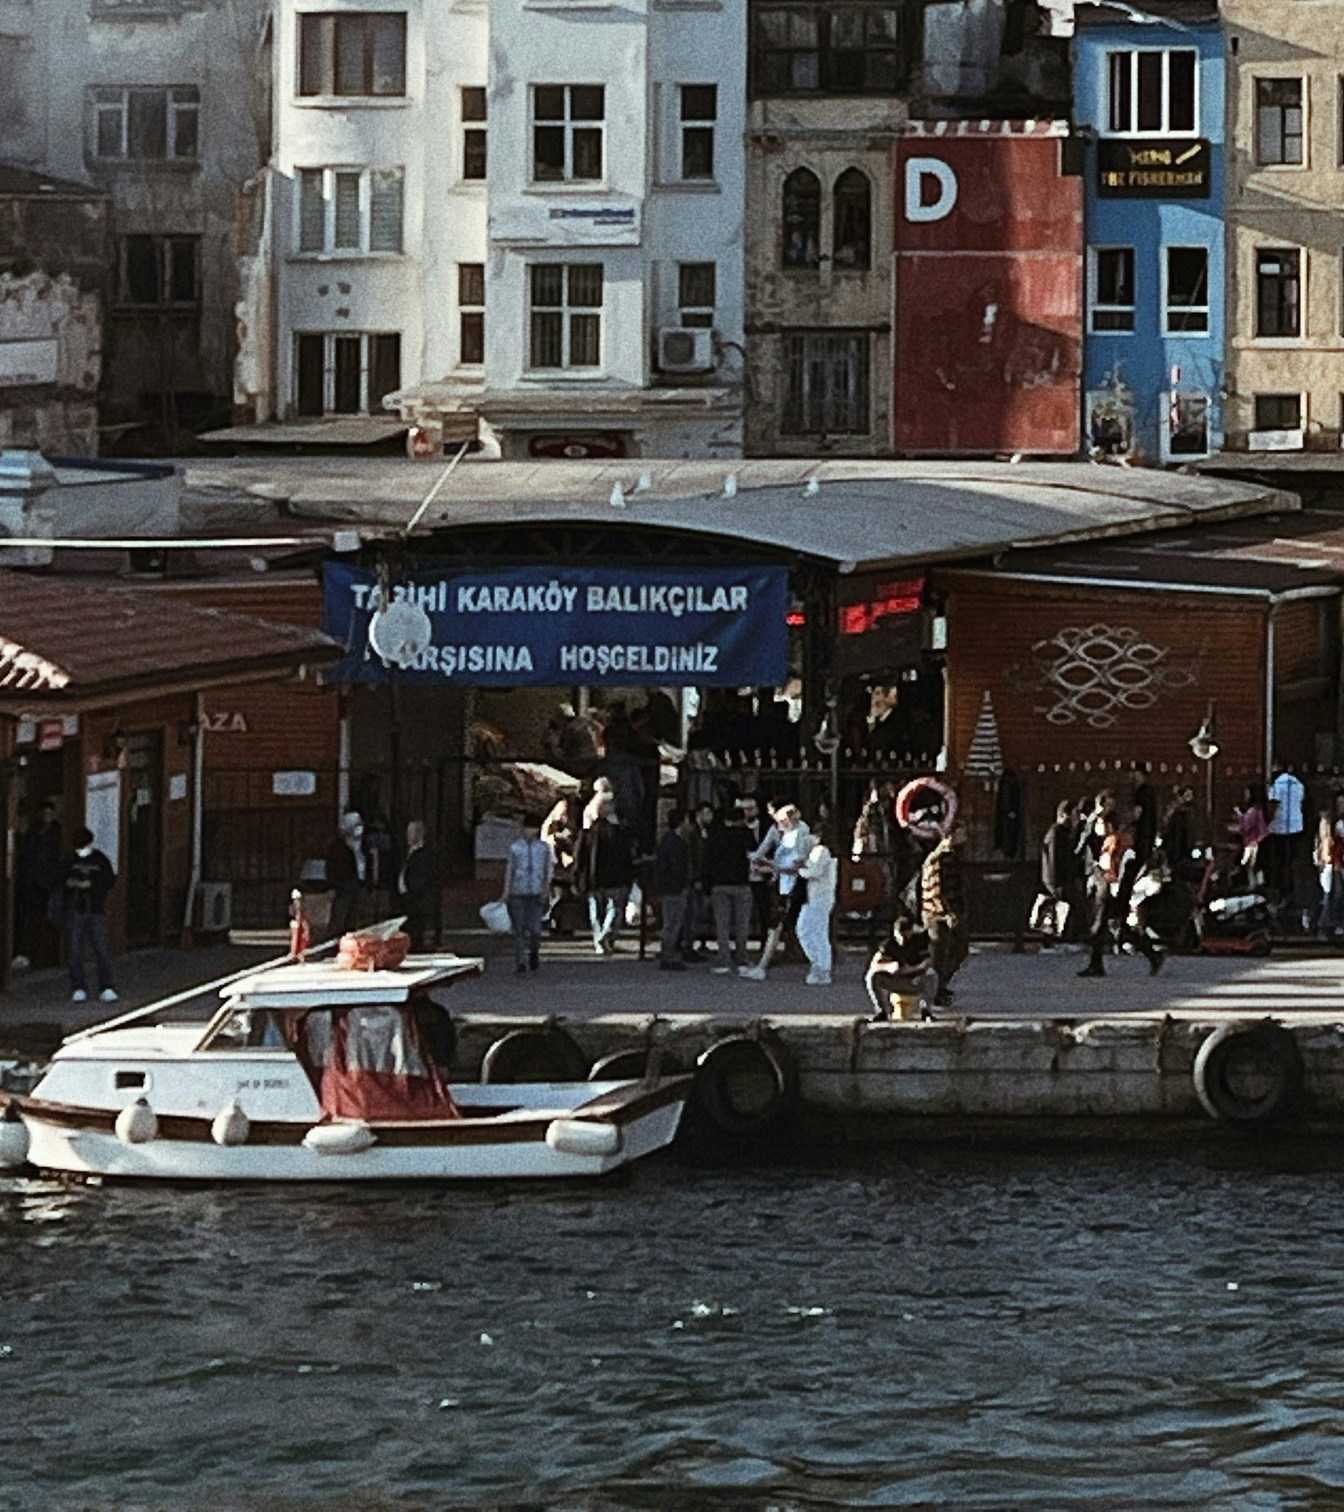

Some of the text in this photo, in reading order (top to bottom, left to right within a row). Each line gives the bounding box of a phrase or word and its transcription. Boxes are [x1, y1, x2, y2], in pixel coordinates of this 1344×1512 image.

[905, 157, 958, 223] D
[457, 579, 578, 614] KARAKÖY
[586, 584, 749, 618] BALIKÇILAR
